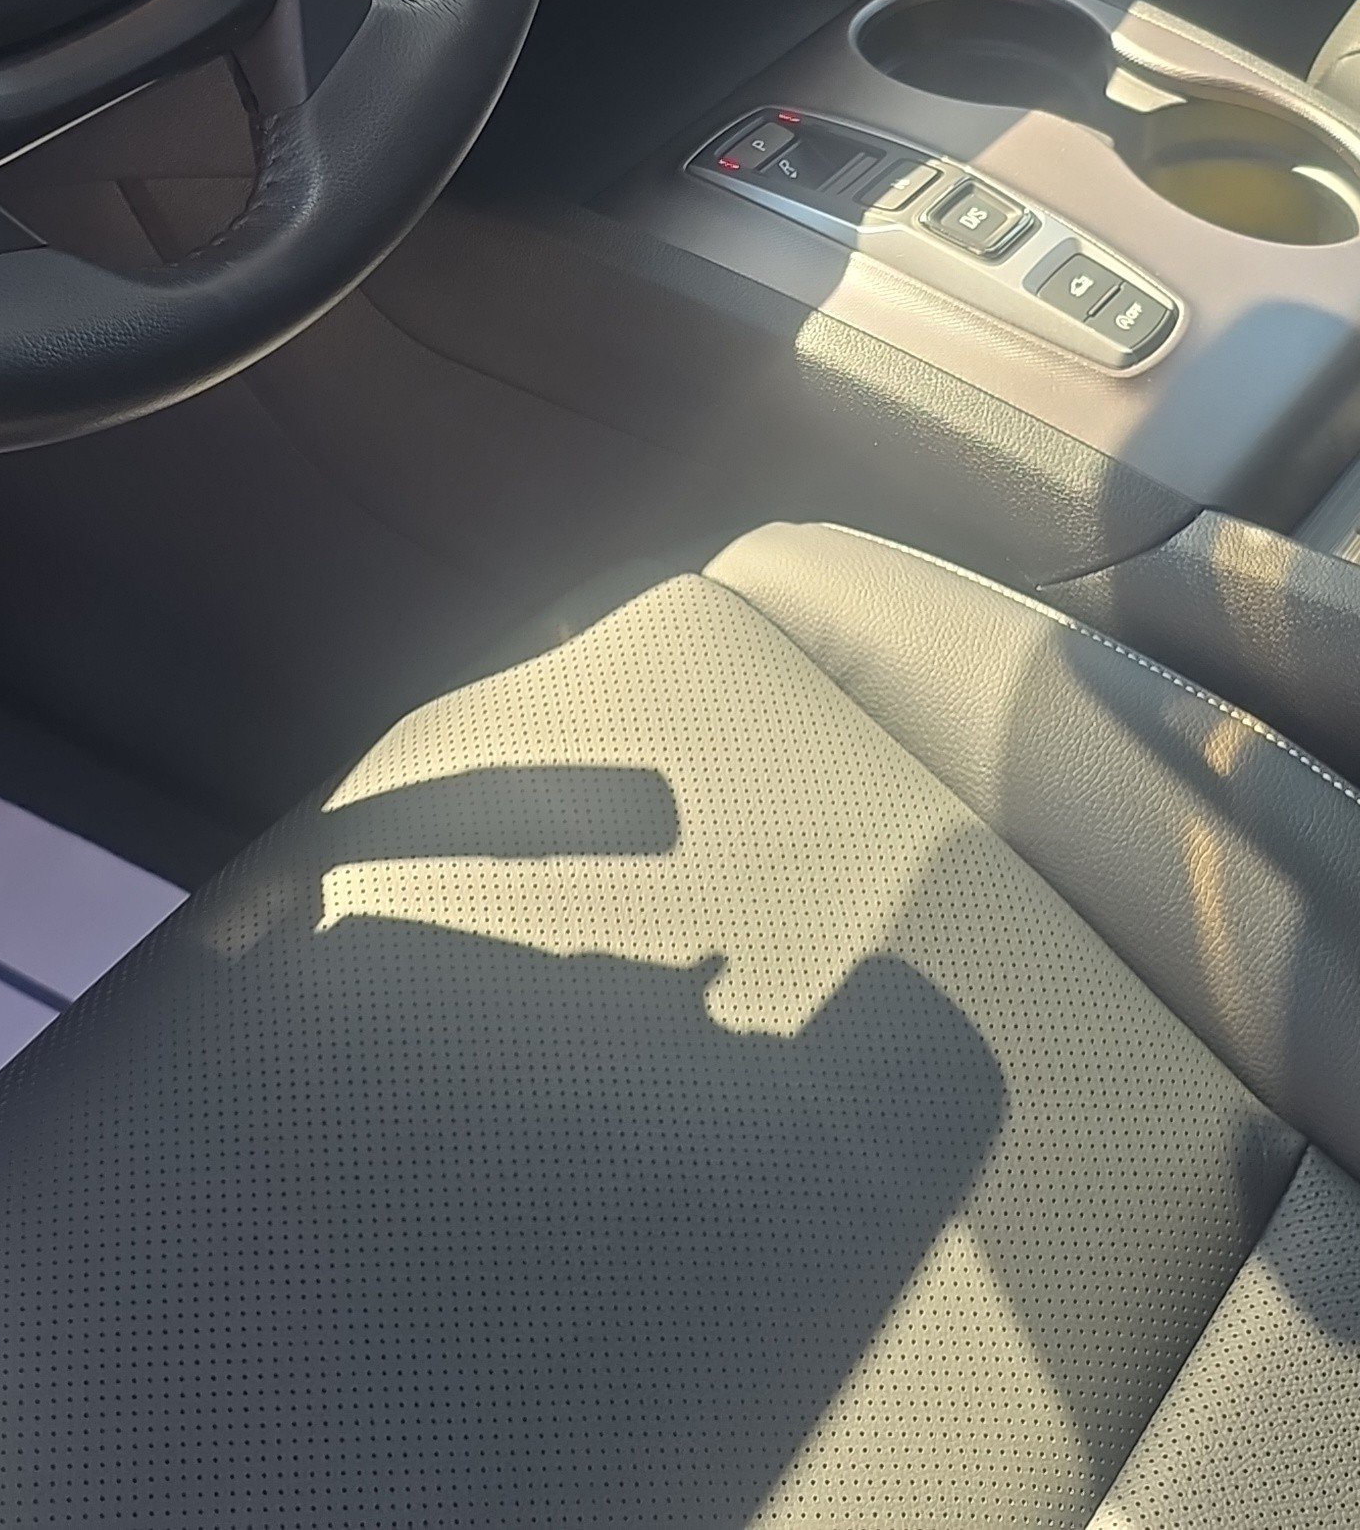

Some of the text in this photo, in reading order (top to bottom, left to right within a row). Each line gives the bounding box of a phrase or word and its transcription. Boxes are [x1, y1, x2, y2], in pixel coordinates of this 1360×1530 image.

[751, 139, 766, 152] P
[778, 159, 793, 176] R
[958, 206, 989, 231] D/S
